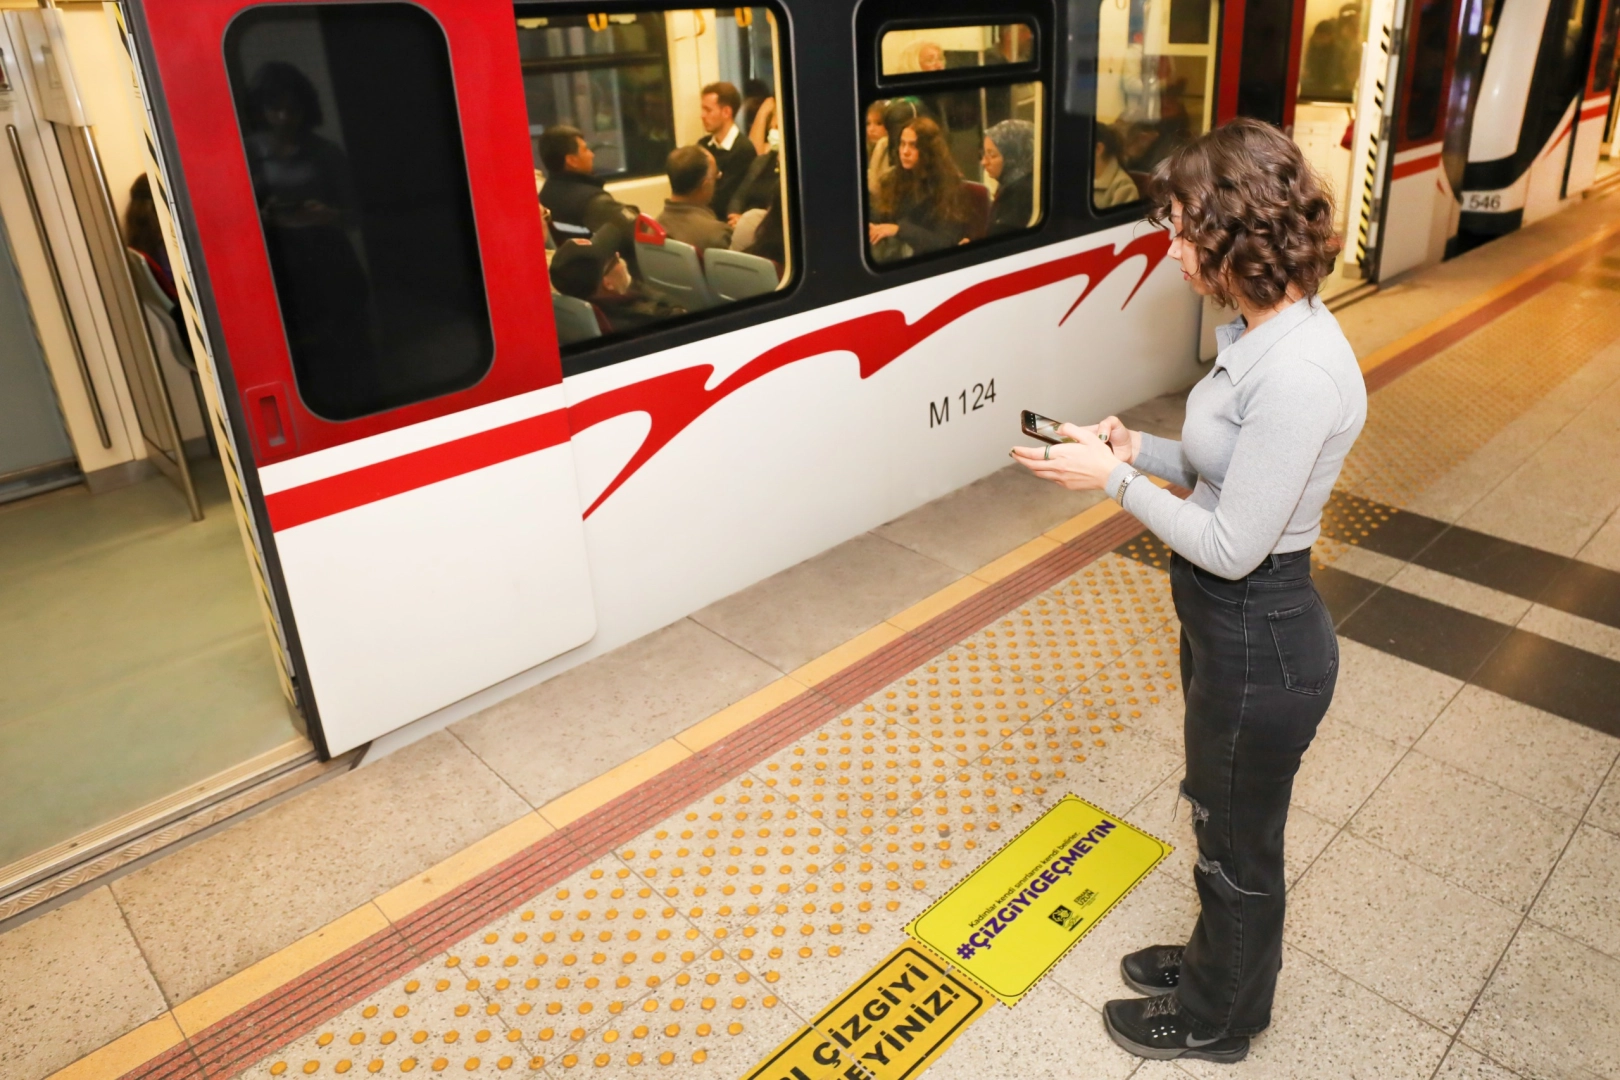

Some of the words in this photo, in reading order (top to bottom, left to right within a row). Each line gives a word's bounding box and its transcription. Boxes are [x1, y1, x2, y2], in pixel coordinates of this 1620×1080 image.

[1469, 194, 1500, 210] 546
[930, 396, 949, 428] M
[959, 377, 996, 415] 124
[995, 887, 1016, 904] kendi
[1040, 849, 1059, 864] kendi
[812, 963, 929, 1068] ÇİZGİYİ
